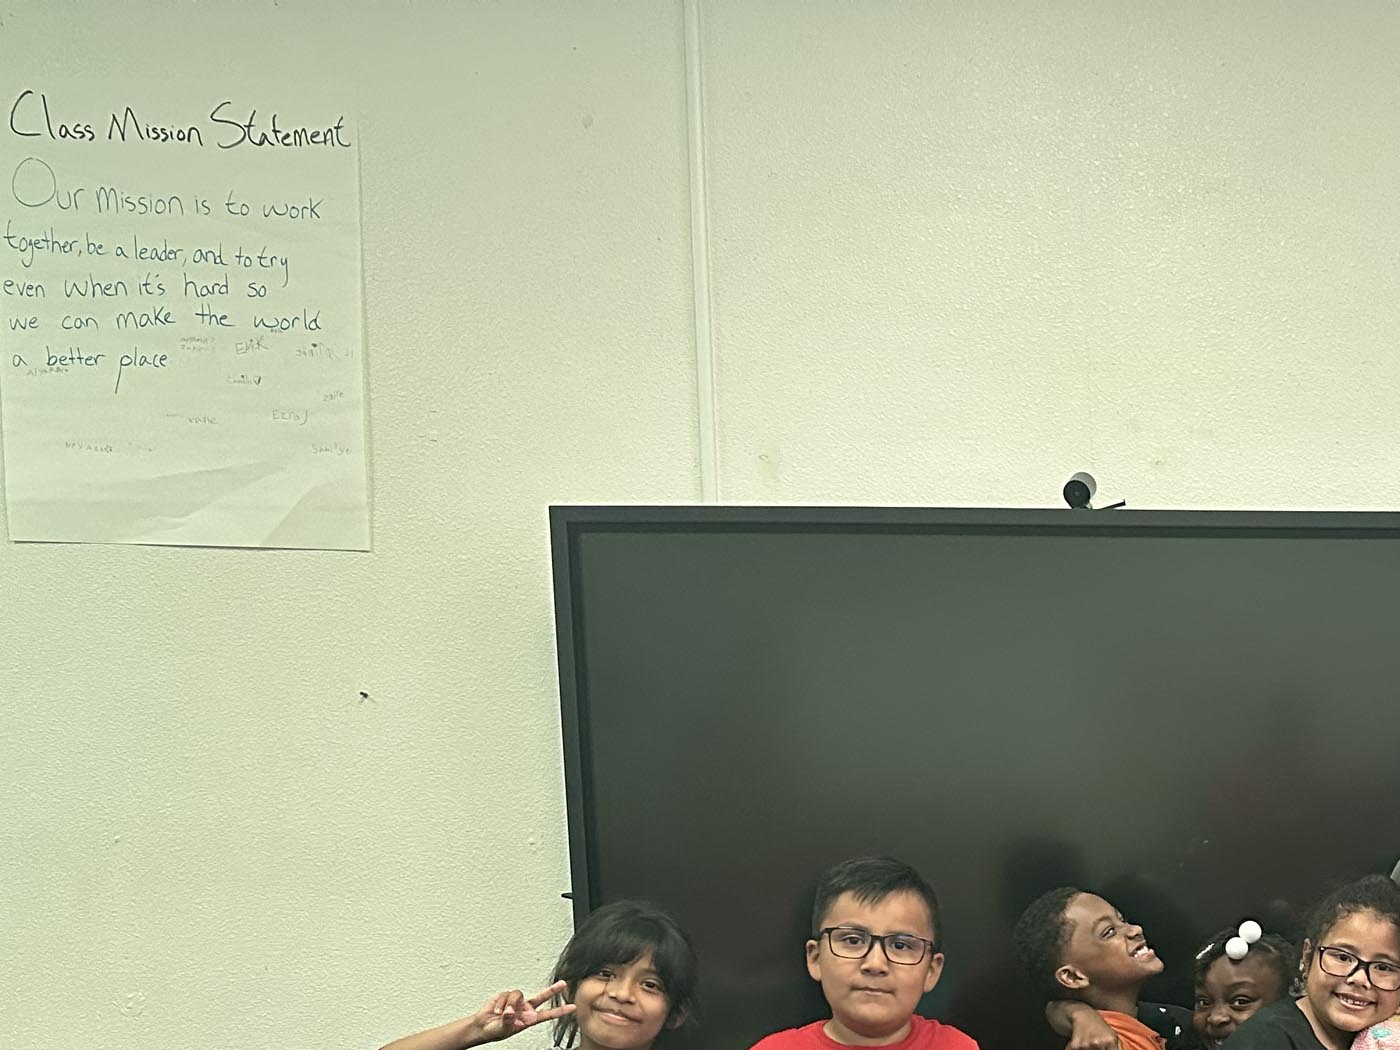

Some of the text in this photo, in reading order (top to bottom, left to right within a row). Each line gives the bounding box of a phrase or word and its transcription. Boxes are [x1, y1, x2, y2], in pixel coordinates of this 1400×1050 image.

[9, 89, 352, 150] Class Mission Statement
[11, 156, 85, 211] Our
[195, 197, 211, 216] is
[224, 190, 250, 217] to
[262, 197, 324, 220] work
[2, 219, 290, 289] together, be a leader, and to try
[2, 279, 46, 298] even
[138, 271, 166, 297] it's
[183, 272, 229, 299] hard
[247, 281, 267, 298] so
[9, 303, 322, 331] we can make the world
[12, 345, 168, 395] a better place
